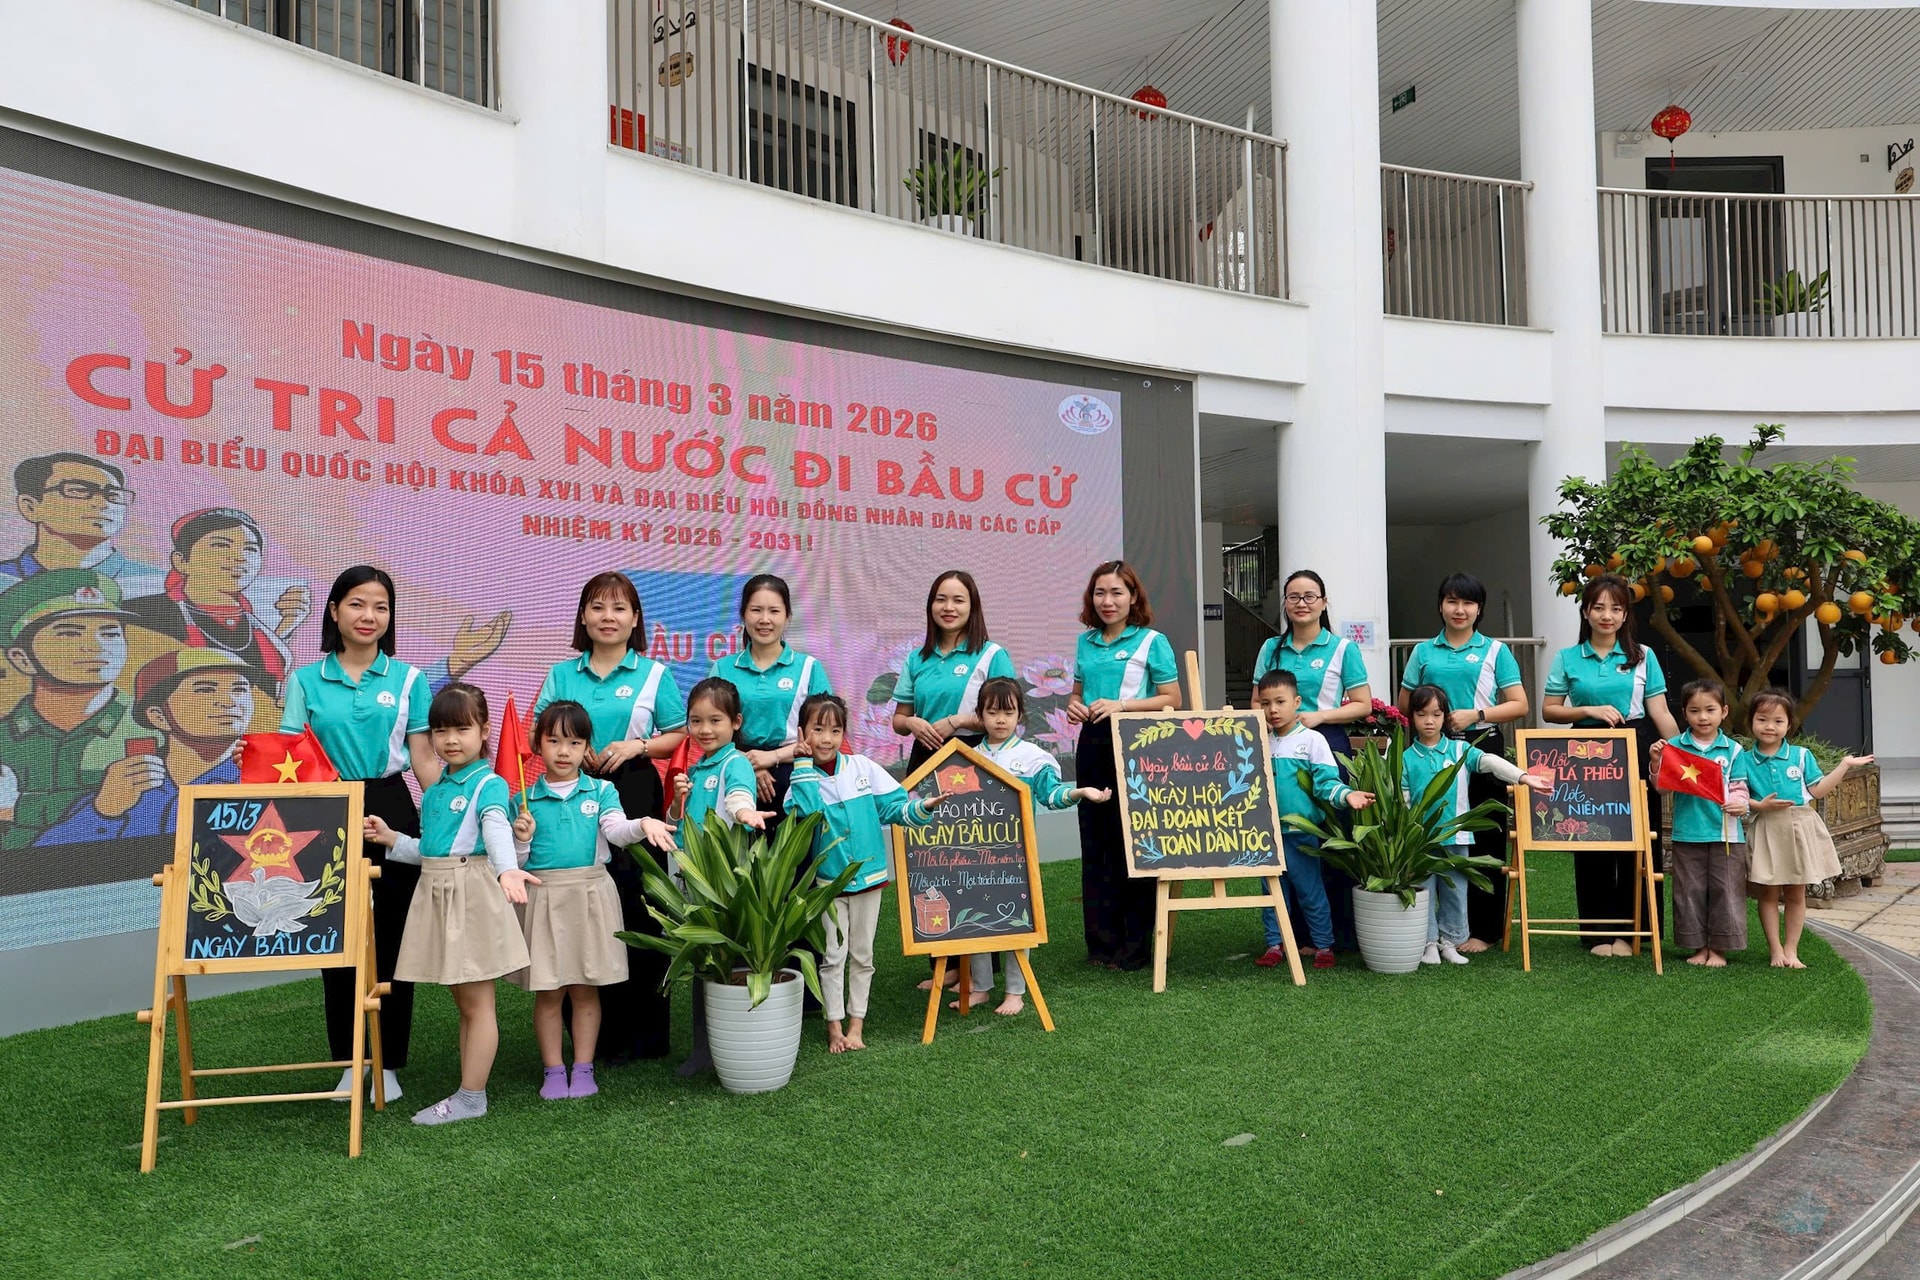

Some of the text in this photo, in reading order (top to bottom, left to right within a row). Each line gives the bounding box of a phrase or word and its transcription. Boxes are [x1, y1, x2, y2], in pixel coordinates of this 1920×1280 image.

[342, 319, 938, 442] Ngày 15 tháng 3 năm 2026
[65, 347, 1079, 509] CỬ TRI CẢ NƯỚC ĐI BẦU CỬ
[95, 430, 1062, 536] ĐẠI BIỂU QUỐC HỘI KHÓA XVI VÀ ĐẠI BIỂU HỘI ĐỒNG NHÂN DÂN CÁC CẤP
[522, 514, 612, 543] NHIỆM
[622, 520, 653, 543] KỲ
[663, 524, 723, 547] 2026
[750, 531, 813, 551] 2031!
[650, 622, 693, 662] ẦU
[1140, 756, 1169, 784] Ngày
[1172, 752, 1193, 772] bầu
[1195, 755, 1210, 772] cử
[1530, 749, 1570, 768] Mỗi
[1557, 764, 1577, 780] LÁ
[1583, 759, 1624, 780] PHIẾU
[933, 797, 1005, 819] HÀO MỪNG
[1148, 781, 1222, 808] NGÀY HỘI
[1549, 782, 1586, 803] Một
[1568, 797, 1631, 816] NIỀM TIN
[206, 800, 262, 831] 15/3
[908, 814, 1021, 847] NGÀY BẦU CỬ
[1131, 801, 1245, 831] ĐẠI ĐOÀN KẾT
[1158, 828, 1202, 856] TOÀN
[1205, 826, 1239, 853] DÂN
[190, 923, 338, 959] NGÀY BẦU CỬ
